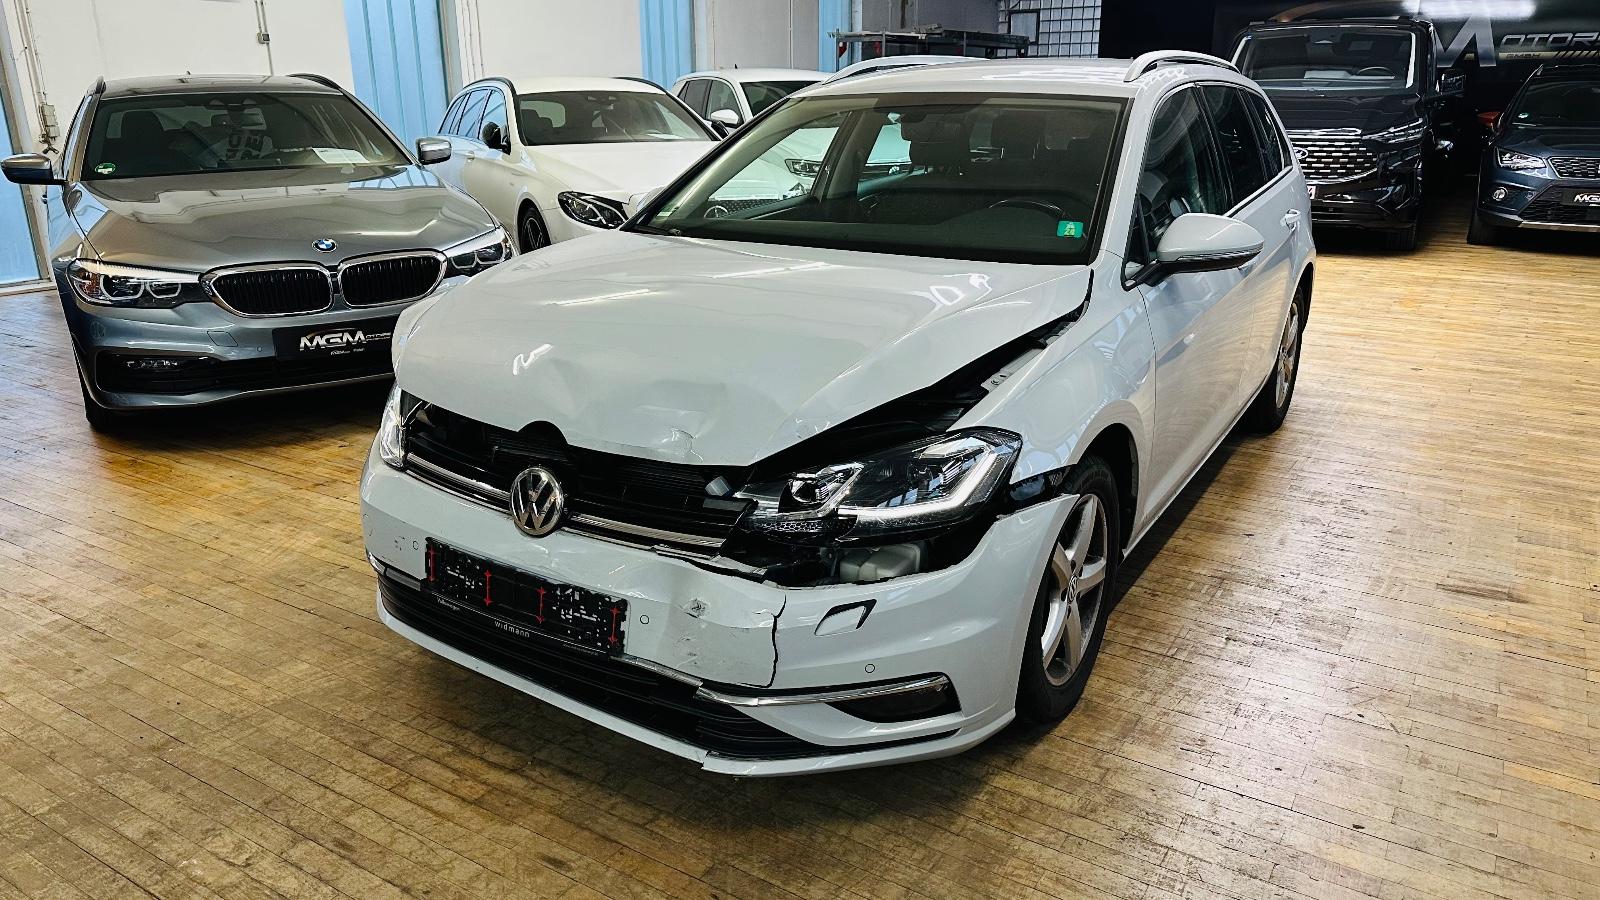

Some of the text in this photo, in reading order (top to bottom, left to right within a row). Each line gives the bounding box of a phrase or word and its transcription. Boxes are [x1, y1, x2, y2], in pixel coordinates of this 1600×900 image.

[1500, 32, 1600, 48] OTOR
[1574, 194, 1600, 203] MG
[494, 620, 530, 638] widmann
